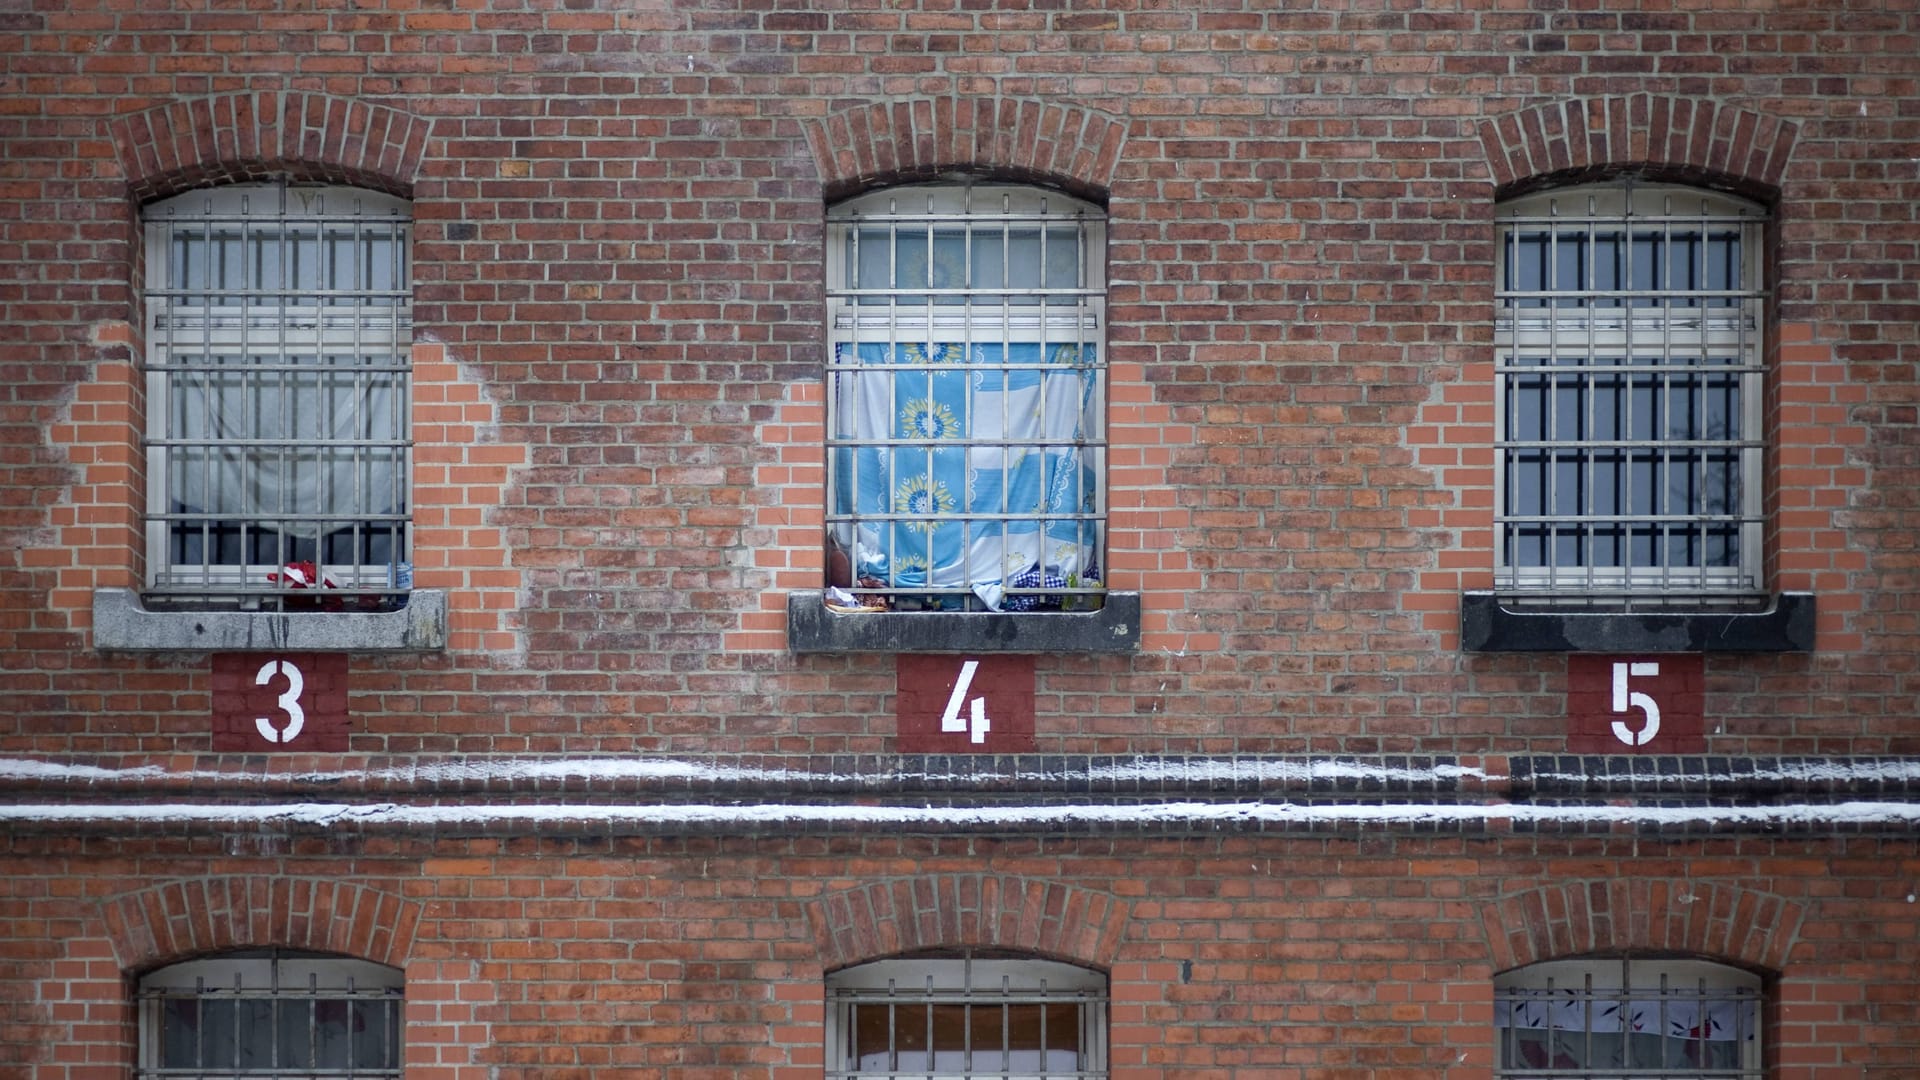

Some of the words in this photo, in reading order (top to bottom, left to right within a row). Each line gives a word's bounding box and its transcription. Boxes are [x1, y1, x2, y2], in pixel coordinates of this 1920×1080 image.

[255, 660, 305, 743] 3
[941, 660, 991, 744] 4
[1611, 662, 1661, 746] 5
